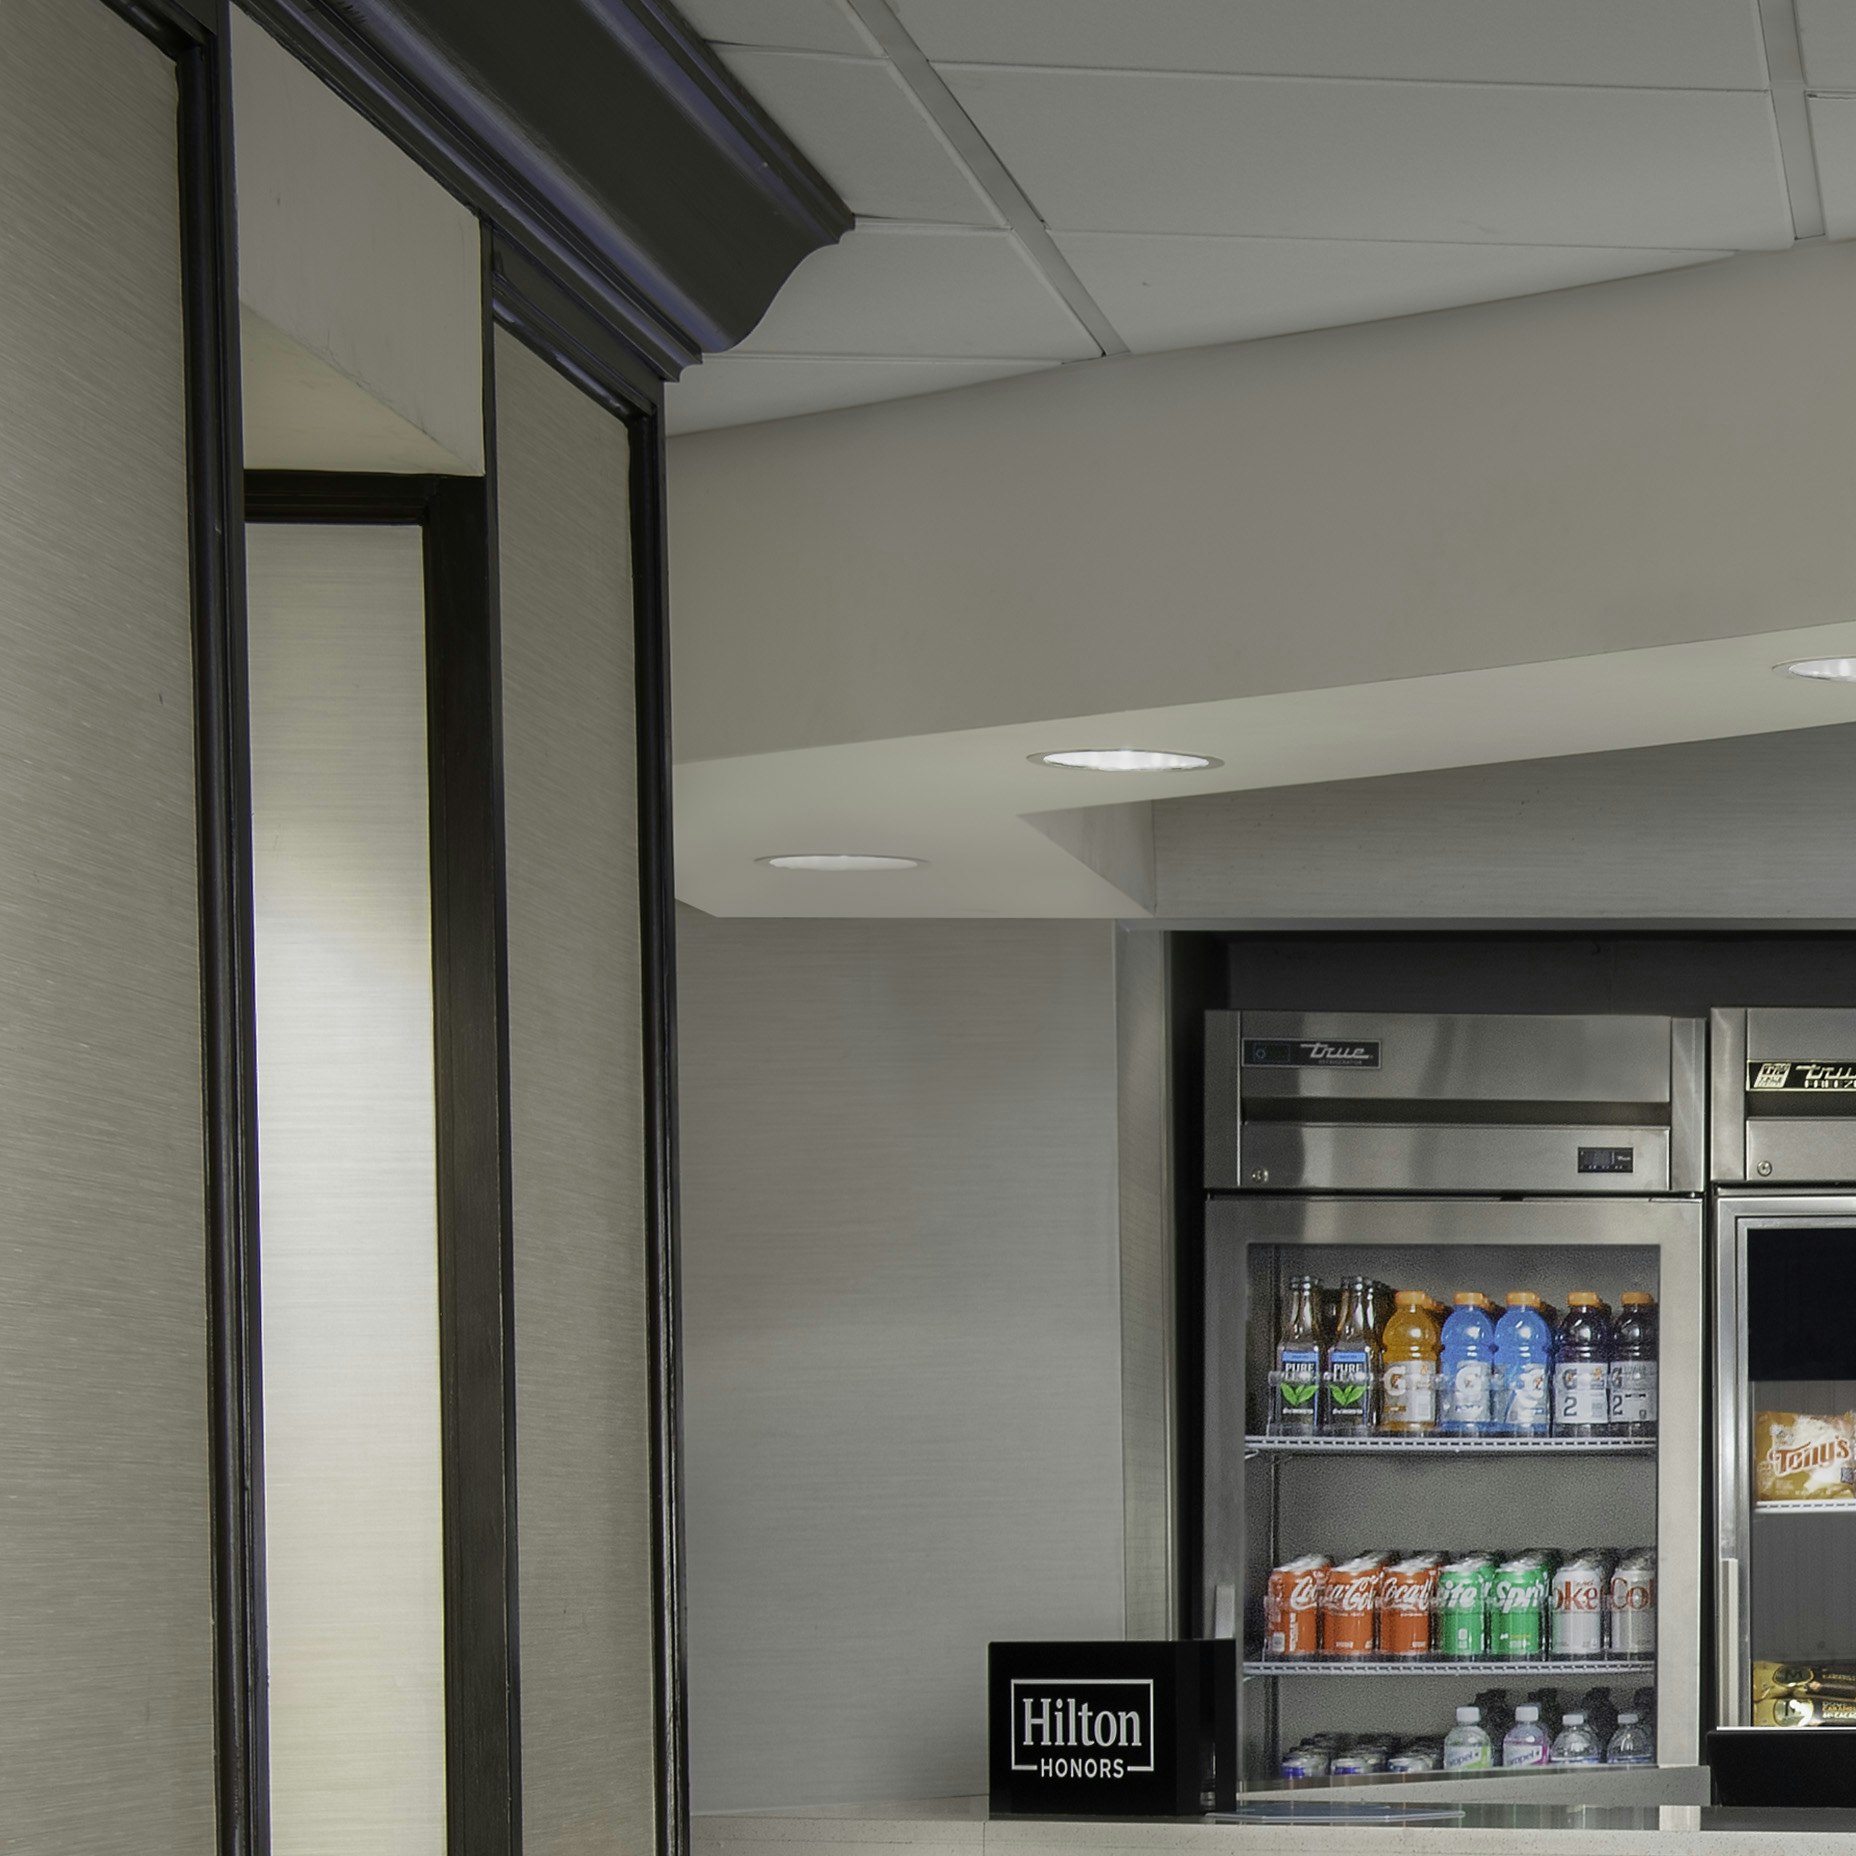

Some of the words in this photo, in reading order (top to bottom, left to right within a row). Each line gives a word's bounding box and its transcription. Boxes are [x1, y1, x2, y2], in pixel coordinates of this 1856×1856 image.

[1333, 1363, 1363, 1374] PURE
[1769, 1436, 1849, 1475] Tony's
[1022, 1697, 1142, 1747] Hilton
[1041, 1758, 1125, 1778] HONORS
